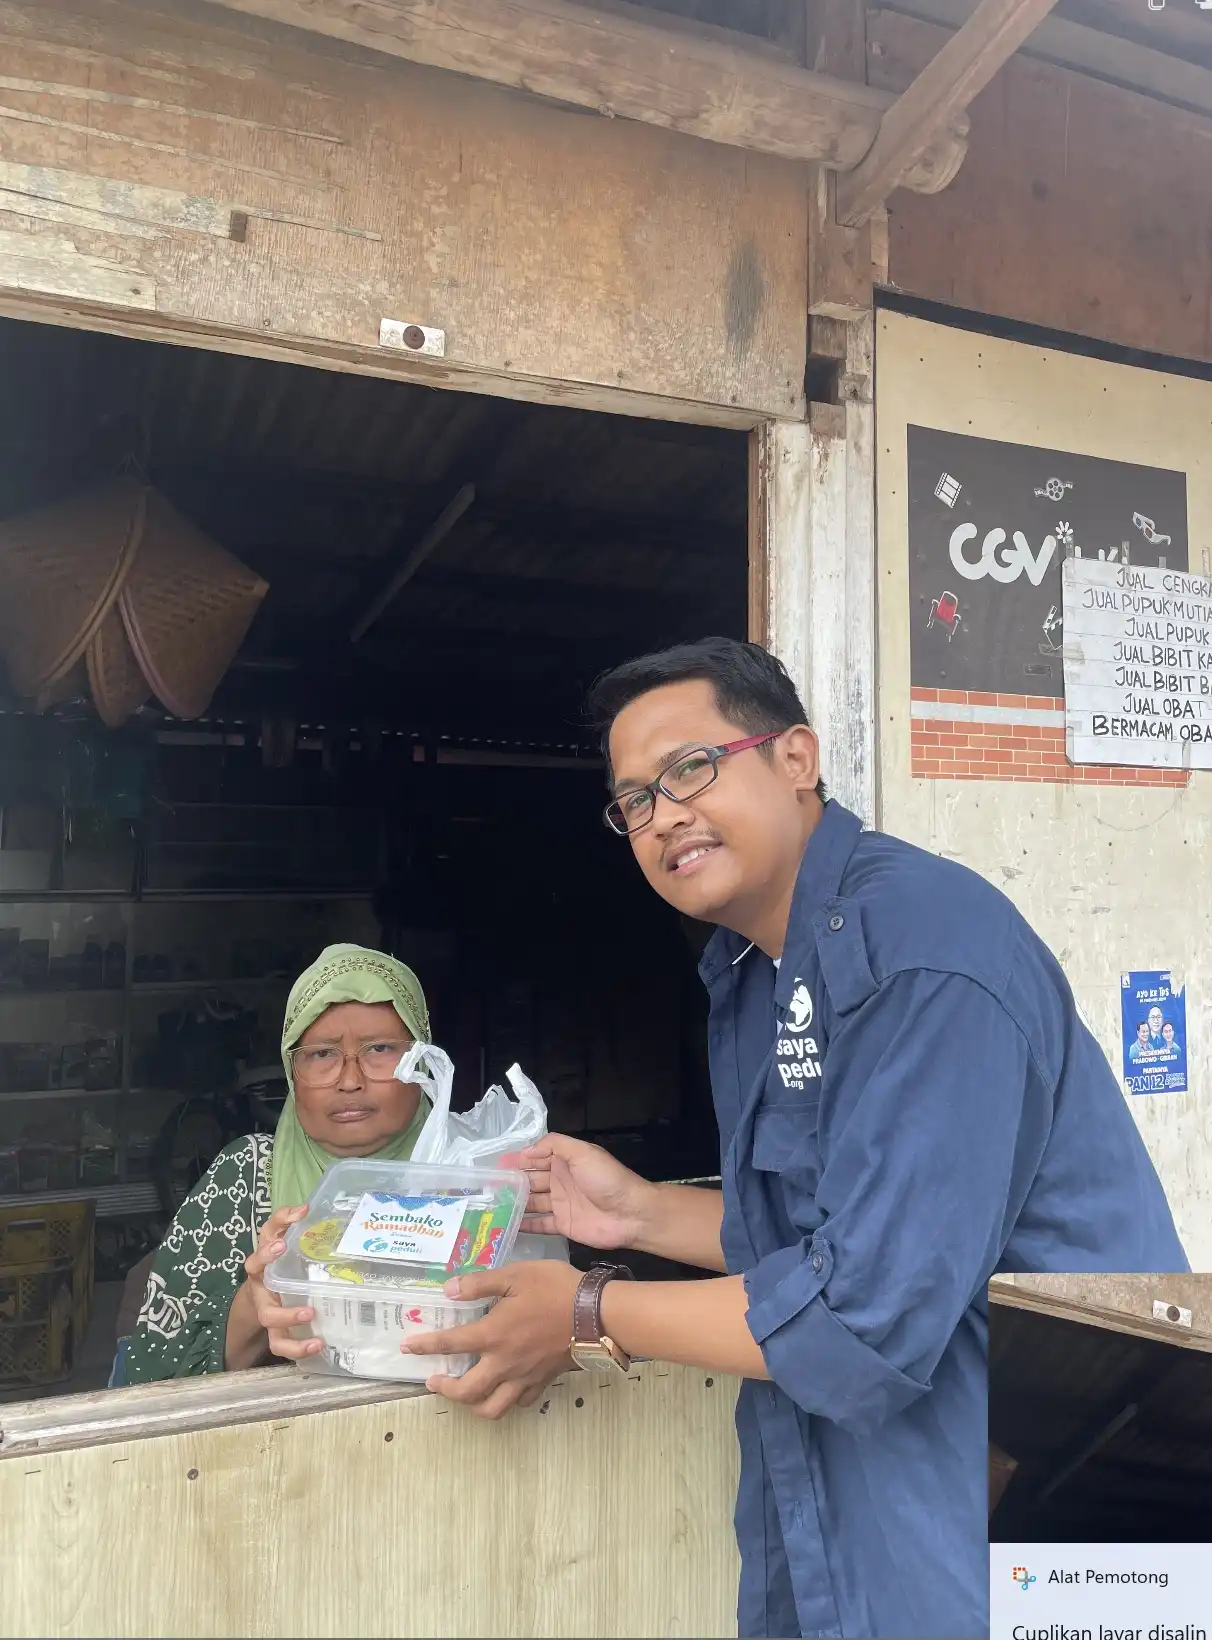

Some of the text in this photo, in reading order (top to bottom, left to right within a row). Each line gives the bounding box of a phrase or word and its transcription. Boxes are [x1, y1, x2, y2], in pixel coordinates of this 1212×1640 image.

[949, 522, 1057, 586] CGV
[1116, 566, 1154, 590] JUAL
[1082, 587, 1118, 610] JUAL
[1121, 593, 1170, 615] PUPUK
[1124, 616, 1210, 646] JUAL PUPUK
[1113, 640, 1150, 664] JUAL
[1151, 644, 1193, 668] BIBIT
[1114, 665, 1212, 695] JUAL BIBIT B
[1122, 692, 1204, 719] JUAL OBAT
[1092, 714, 1173, 741] BERMACAM
[1136, 986, 1170, 999] AYO KE TPS
[776, 1037, 819, 1059] saya
[1125, 1075, 1150, 1092] PAN
[1150, 1074, 1165, 1090] 12
[361, 1220, 445, 1239] Ramadhan
[369, 1211, 444, 1228] Sembako
